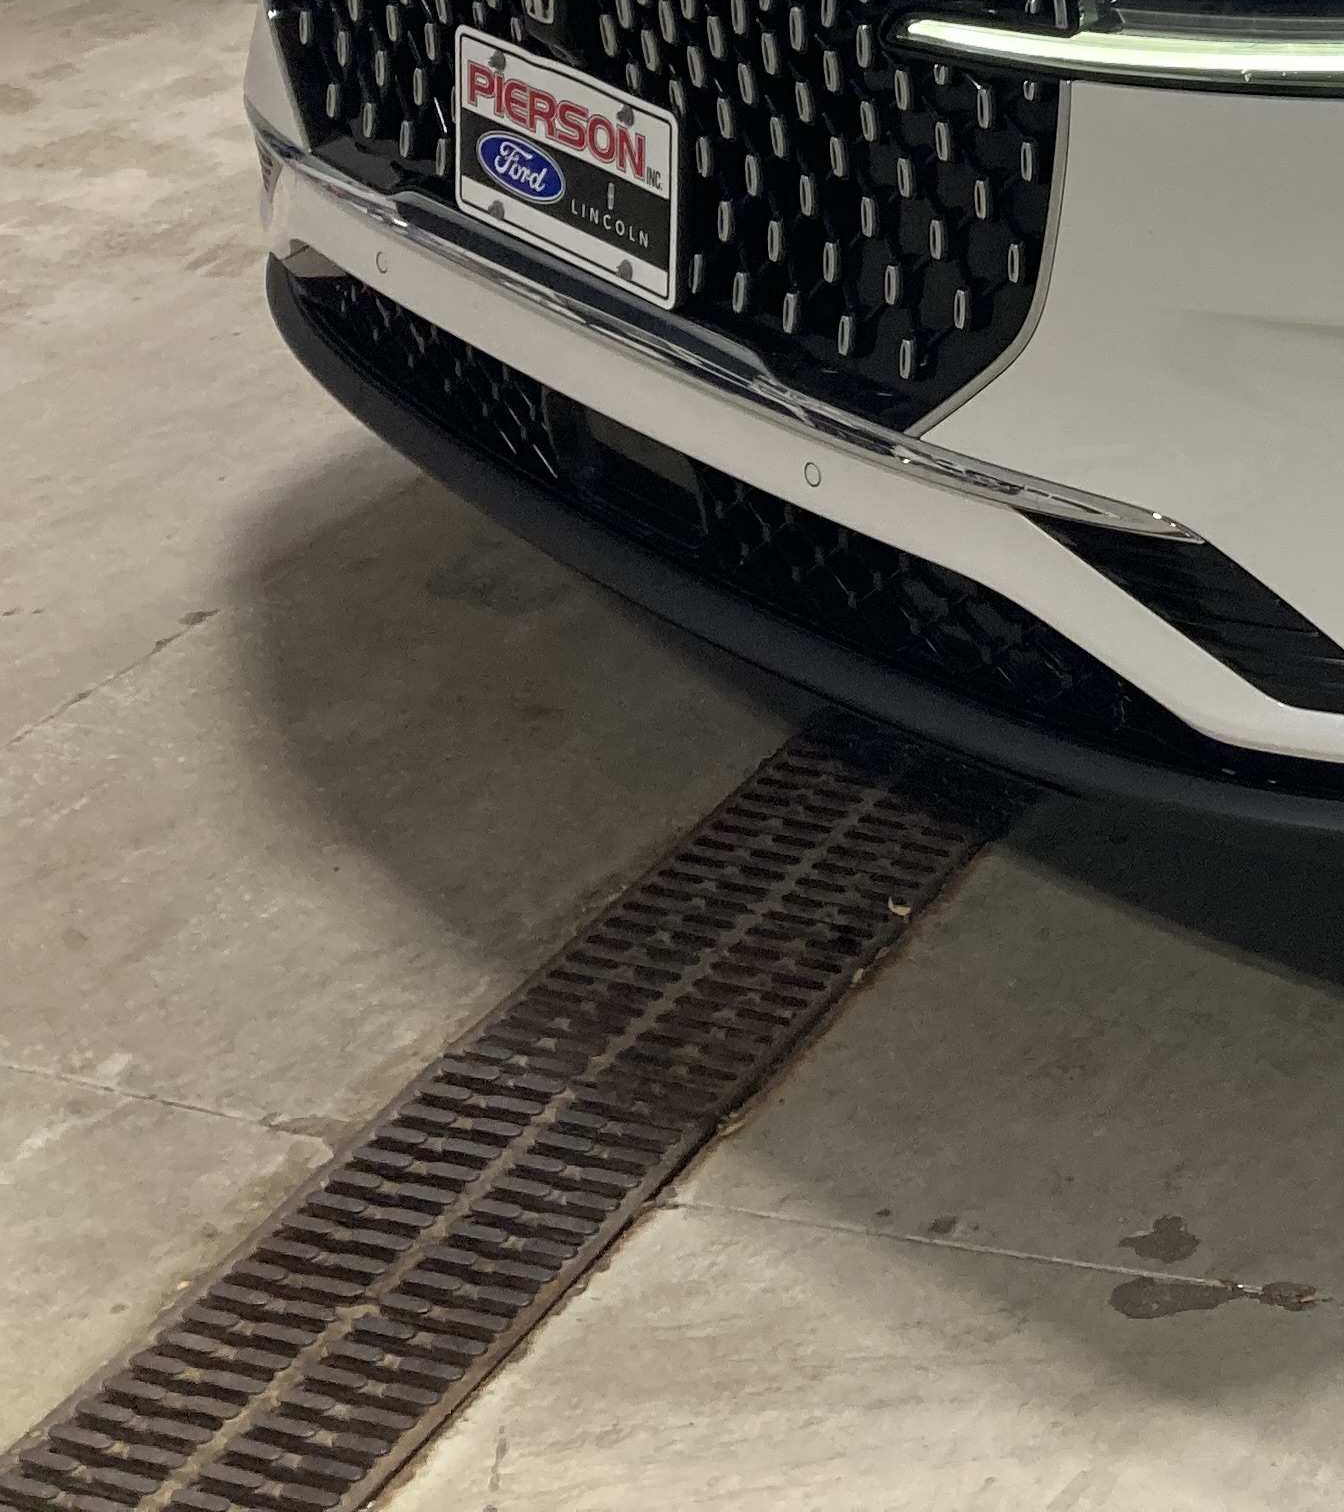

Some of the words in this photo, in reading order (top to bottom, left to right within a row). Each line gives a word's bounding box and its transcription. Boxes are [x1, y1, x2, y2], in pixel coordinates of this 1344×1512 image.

[467, 59, 646, 181] PIERSON
[646, 167, 663, 191] INC.
[494, 141, 548, 192] Ford
[571, 199, 649, 248] LINCOLN
